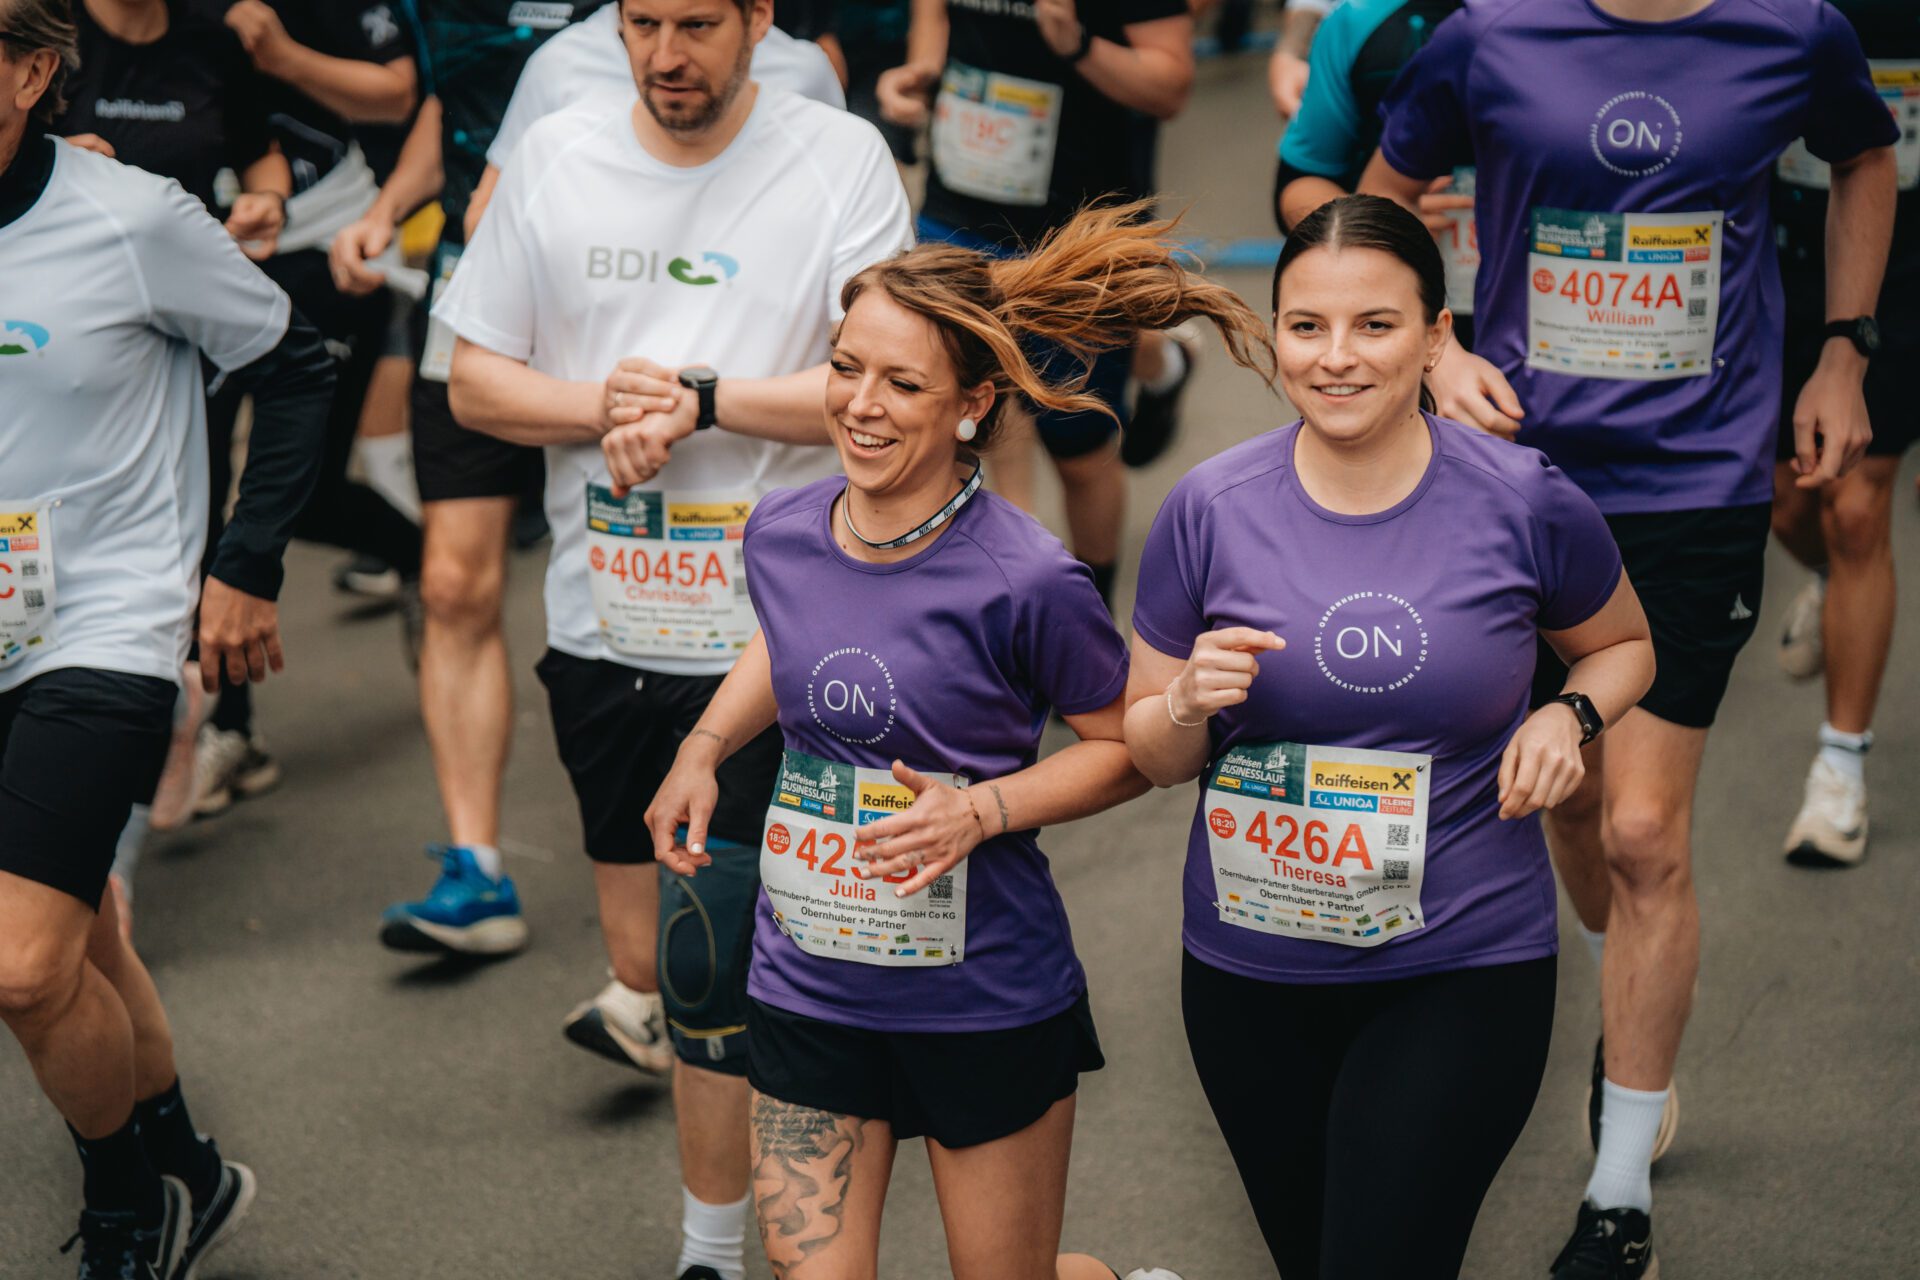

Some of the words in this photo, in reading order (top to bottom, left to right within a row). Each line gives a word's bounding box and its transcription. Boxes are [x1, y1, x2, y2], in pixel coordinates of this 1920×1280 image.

[1632, 233, 1692, 246] Raiffeisen
[587, 246, 660, 283] BDI
[1559, 268, 1684, 309] 4074A
[1586, 309, 1655, 326] William
[943, 503, 957, 519] NIKE
[918, 523, 933, 537] NIKE
[610, 547, 728, 588] 4045A
[1319, 591, 1374, 628] OBERNHUBER
[1386, 593, 1423, 625] PARTNER
[812, 647, 861, 676] OBERNHUBER
[871, 654, 895, 690] PARTNER
[1314, 636, 1384, 694] STEUERBERATUNGS
[1225, 753, 1262, 769] Raiffeisen
[783, 770, 817, 788] Raiffeisen
[1220, 764, 1286, 785] BUSINESSLAUF
[1315, 773, 1389, 791] Raiffeisen
[781, 780, 837, 803] BUSINESSLAUF
[863, 793, 914, 809] Raiffeis
[1333, 796, 1374, 809] UNIQA
[1381, 806, 1413, 814] ZEITUNG
[1382, 798, 1413, 807] KLEINE
[1211, 817, 1235, 829] 18:20
[769, 832, 789, 845] 18:20
[1245, 810, 1374, 870] 426A
[1270, 858, 1346, 888] Theresa
[829, 879, 877, 901] Julia
[1219, 867, 1289, 890] Obernhuber+Partner
[1291, 883, 1354, 901] Steuerberatungs
[1356, 885, 1380, 899] GmbH
[766, 884, 831, 908] Obernhuber+Partner
[833, 901, 898, 918] Steuerberatungs
[900, 910, 926, 919] GmbH
[928, 911, 941, 919] Co
[942, 912, 956, 920] KG
[1260, 889, 1315, 907] Obernhuber
[1327, 901, 1365, 912] Partner
[800, 906, 857, 925] Obernhuber
[859, 917, 866, 925] +
[868, 917, 907, 930] Partner
